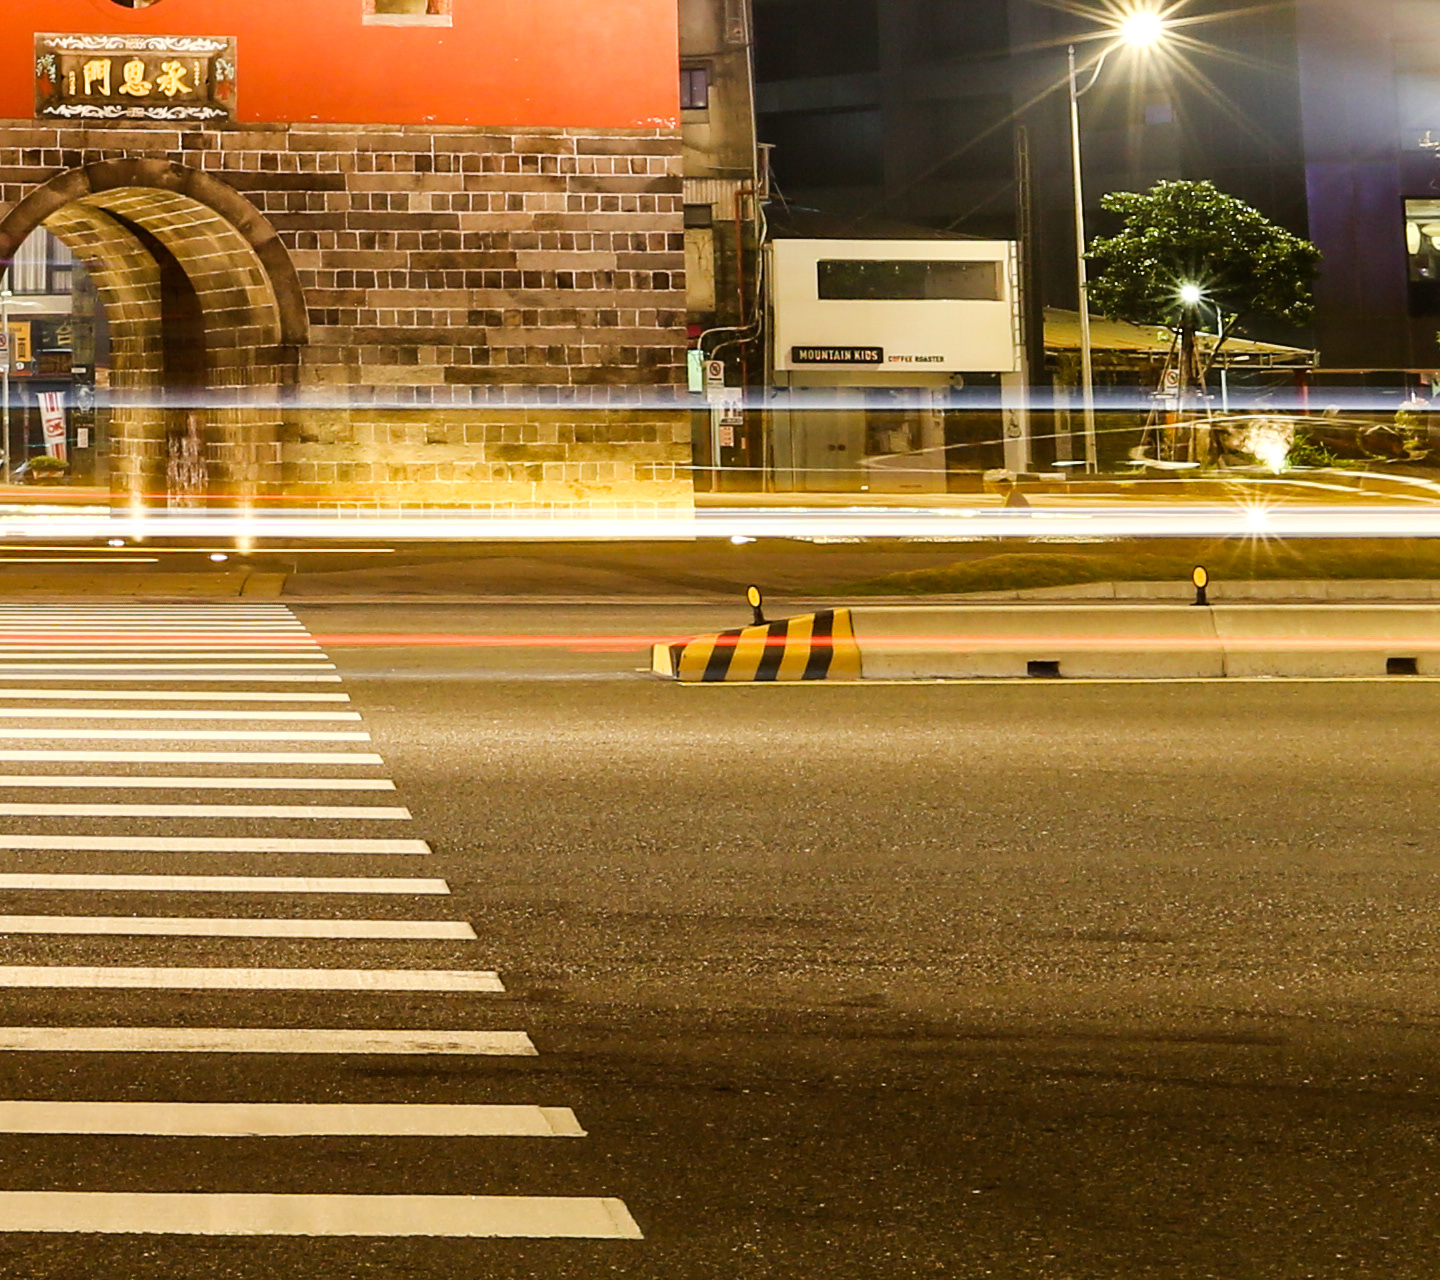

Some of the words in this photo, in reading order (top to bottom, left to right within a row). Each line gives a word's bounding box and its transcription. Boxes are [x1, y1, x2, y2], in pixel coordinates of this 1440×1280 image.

[83, 58, 192, 97] 承恩門
[799, 349, 851, 360] MOUNTAIN
[854, 350, 878, 361] KIDS
[915, 355, 945, 363] ROASTER
